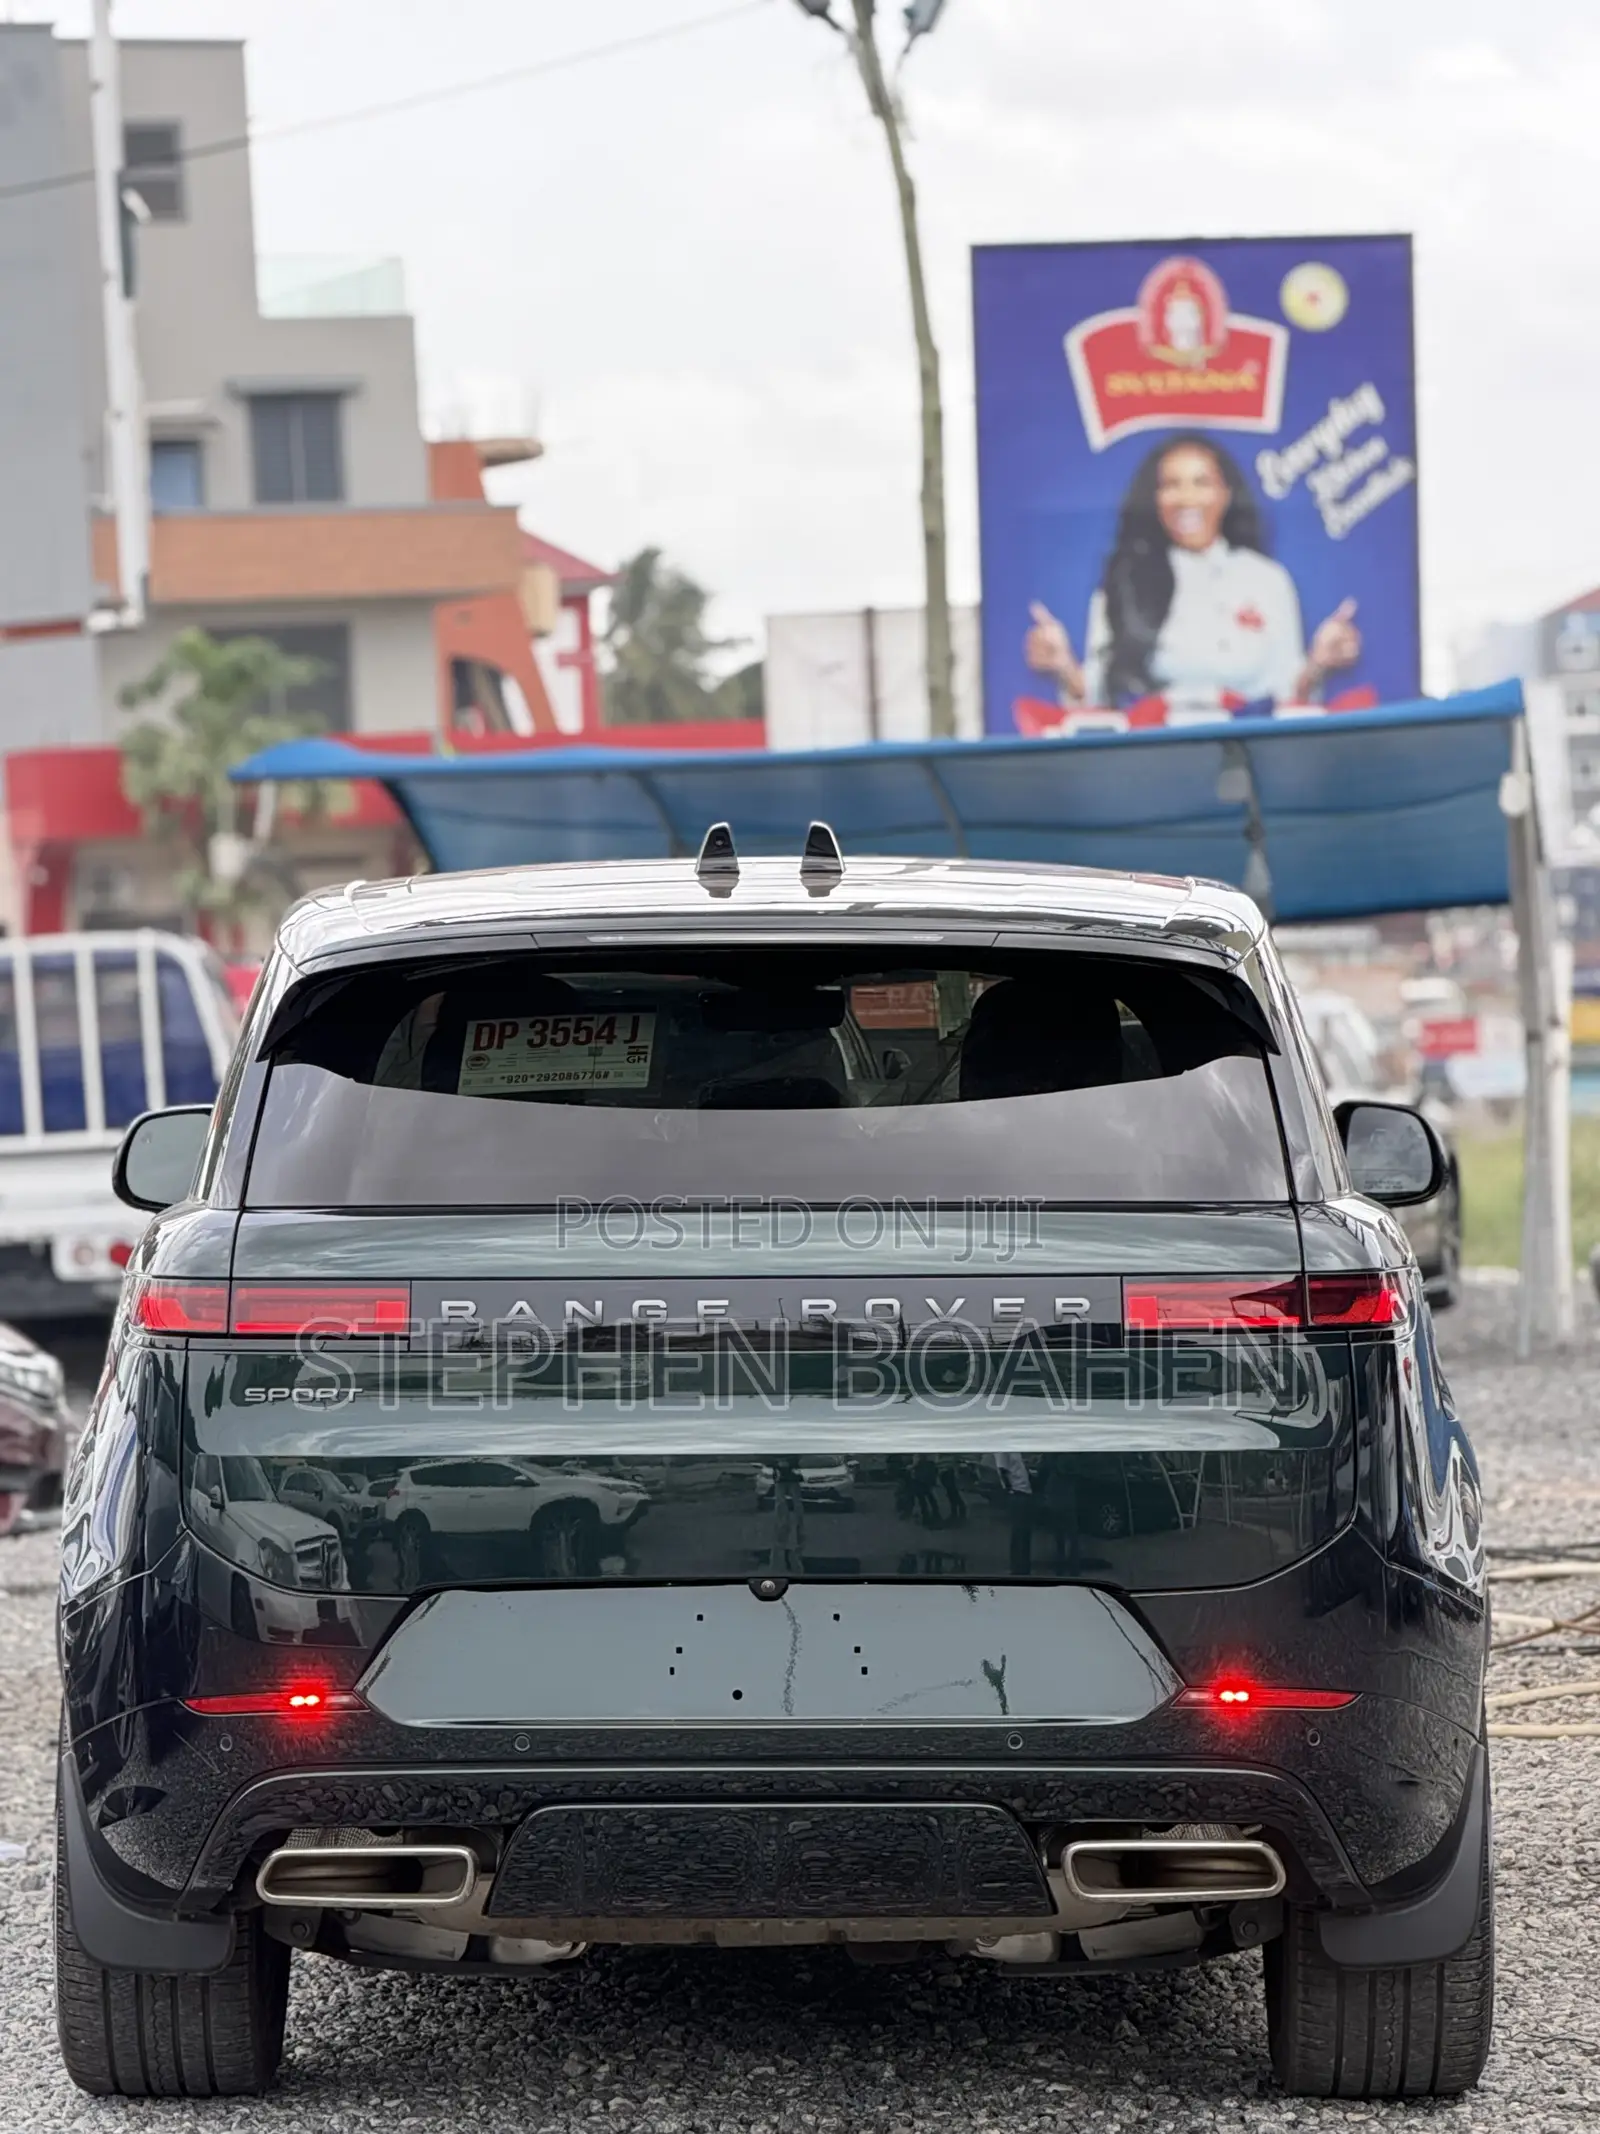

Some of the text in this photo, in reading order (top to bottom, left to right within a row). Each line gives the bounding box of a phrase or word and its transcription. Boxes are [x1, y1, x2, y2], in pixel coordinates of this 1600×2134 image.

[472, 1014, 640, 1052] DP 3554 J
[626, 1055, 649, 1064] GH
[441, 1296, 1092, 1325] RANGE ROVER
[244, 1388, 363, 1403] SPORT
